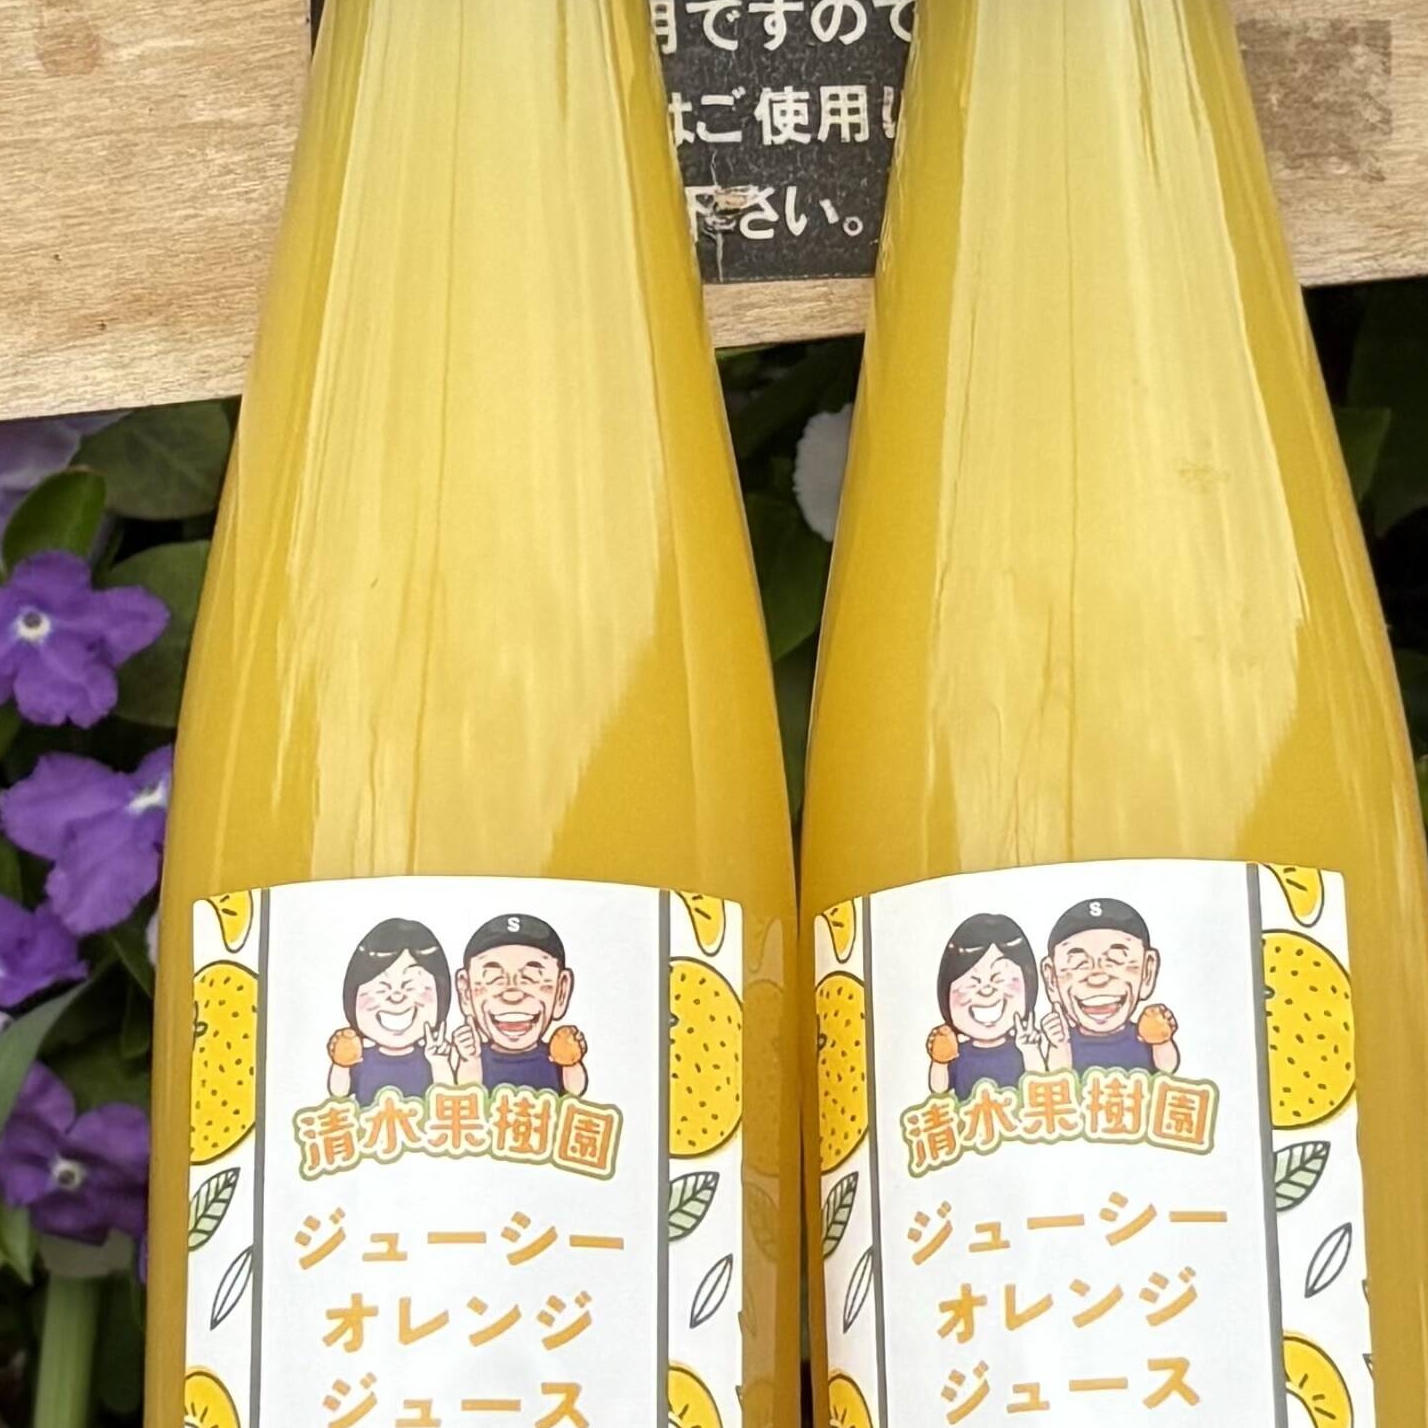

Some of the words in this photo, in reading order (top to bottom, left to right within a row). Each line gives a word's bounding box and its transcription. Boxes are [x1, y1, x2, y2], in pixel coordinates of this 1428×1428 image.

[507, 915, 521, 933] S
[1088, 900, 1103, 918] S
[299, 1091, 617, 1172] 清水果樹園
[904, 1076, 1211, 1169] 清水果樹園
[293, 1206, 625, 1271] ジューシー
[906, 1190, 1229, 1266] ジューシー
[322, 1290, 593, 1354] オレンジ
[936, 1265, 1199, 1345] オレンジ
[939, 1355, 1201, 1426] ジュース
